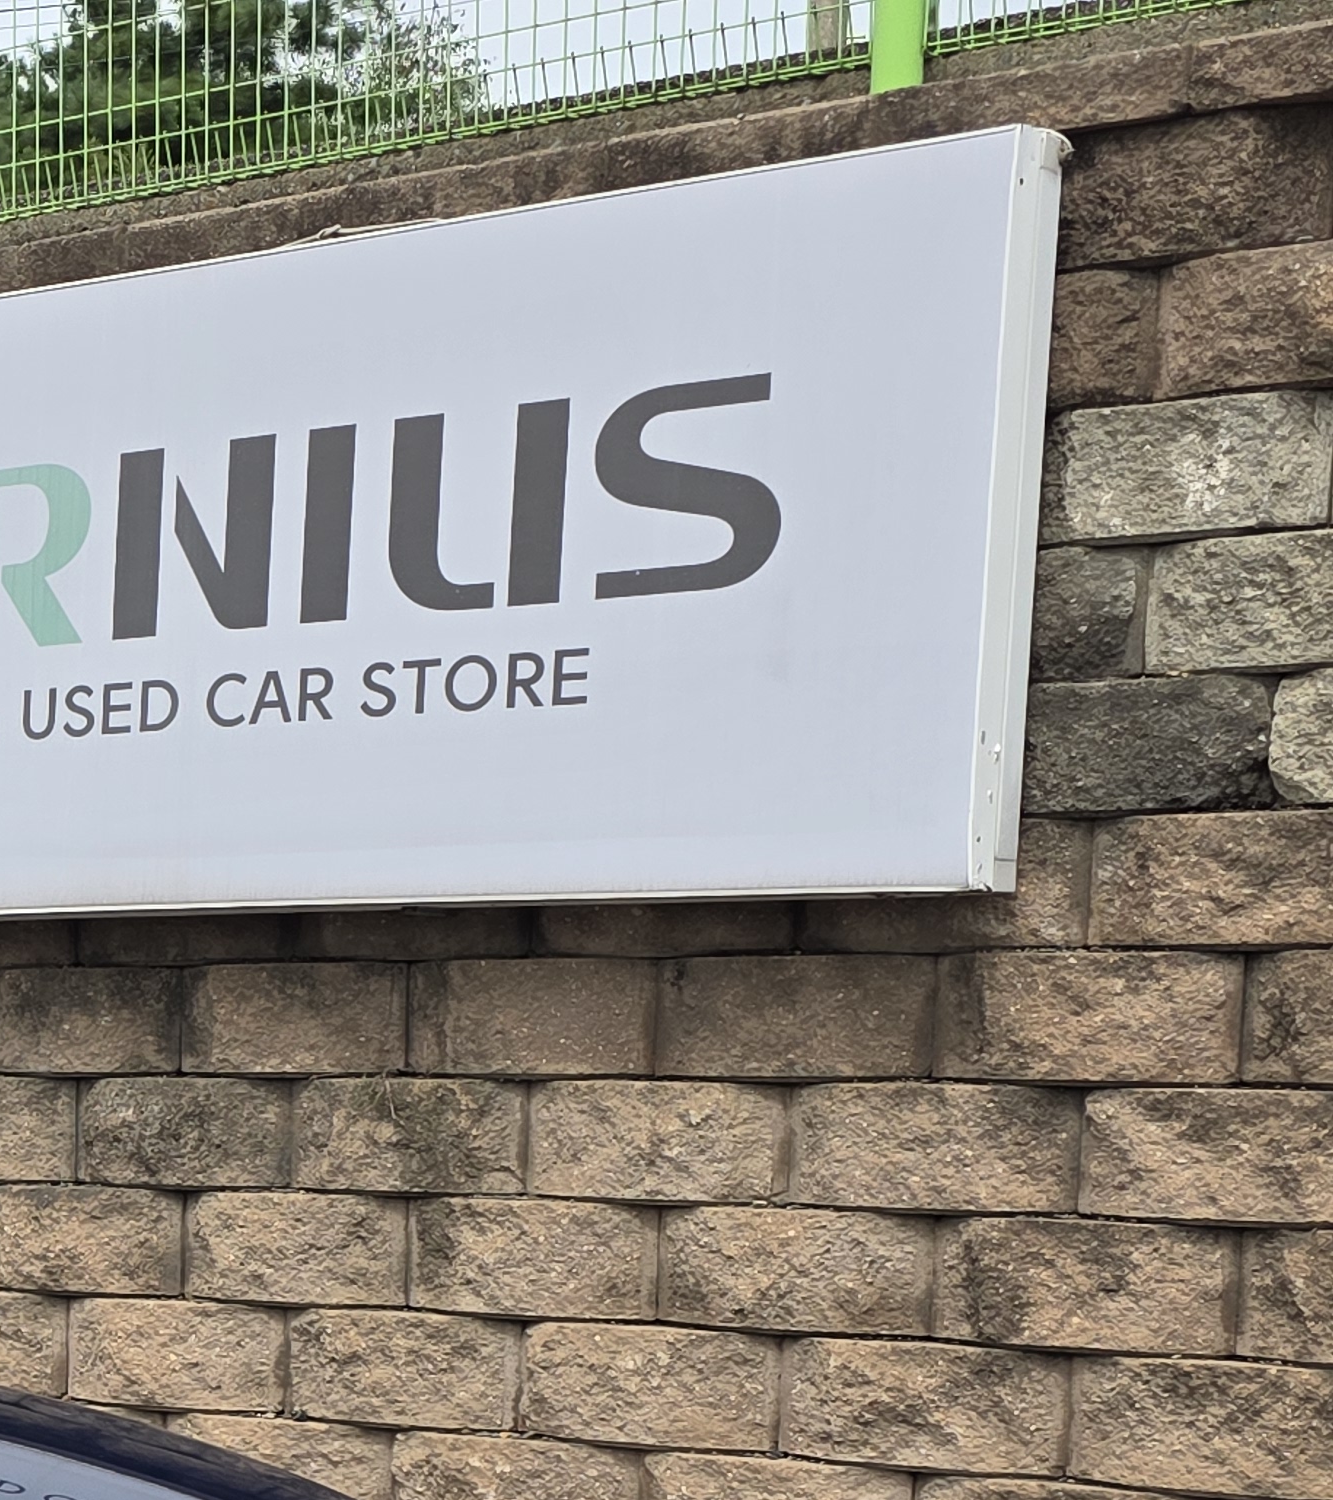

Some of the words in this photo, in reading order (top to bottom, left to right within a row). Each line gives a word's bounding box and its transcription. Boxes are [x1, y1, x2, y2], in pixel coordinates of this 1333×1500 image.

[20, 679, 180, 739] USED
[204, 665, 334, 728] CAR
[360, 647, 591, 720] STORE
